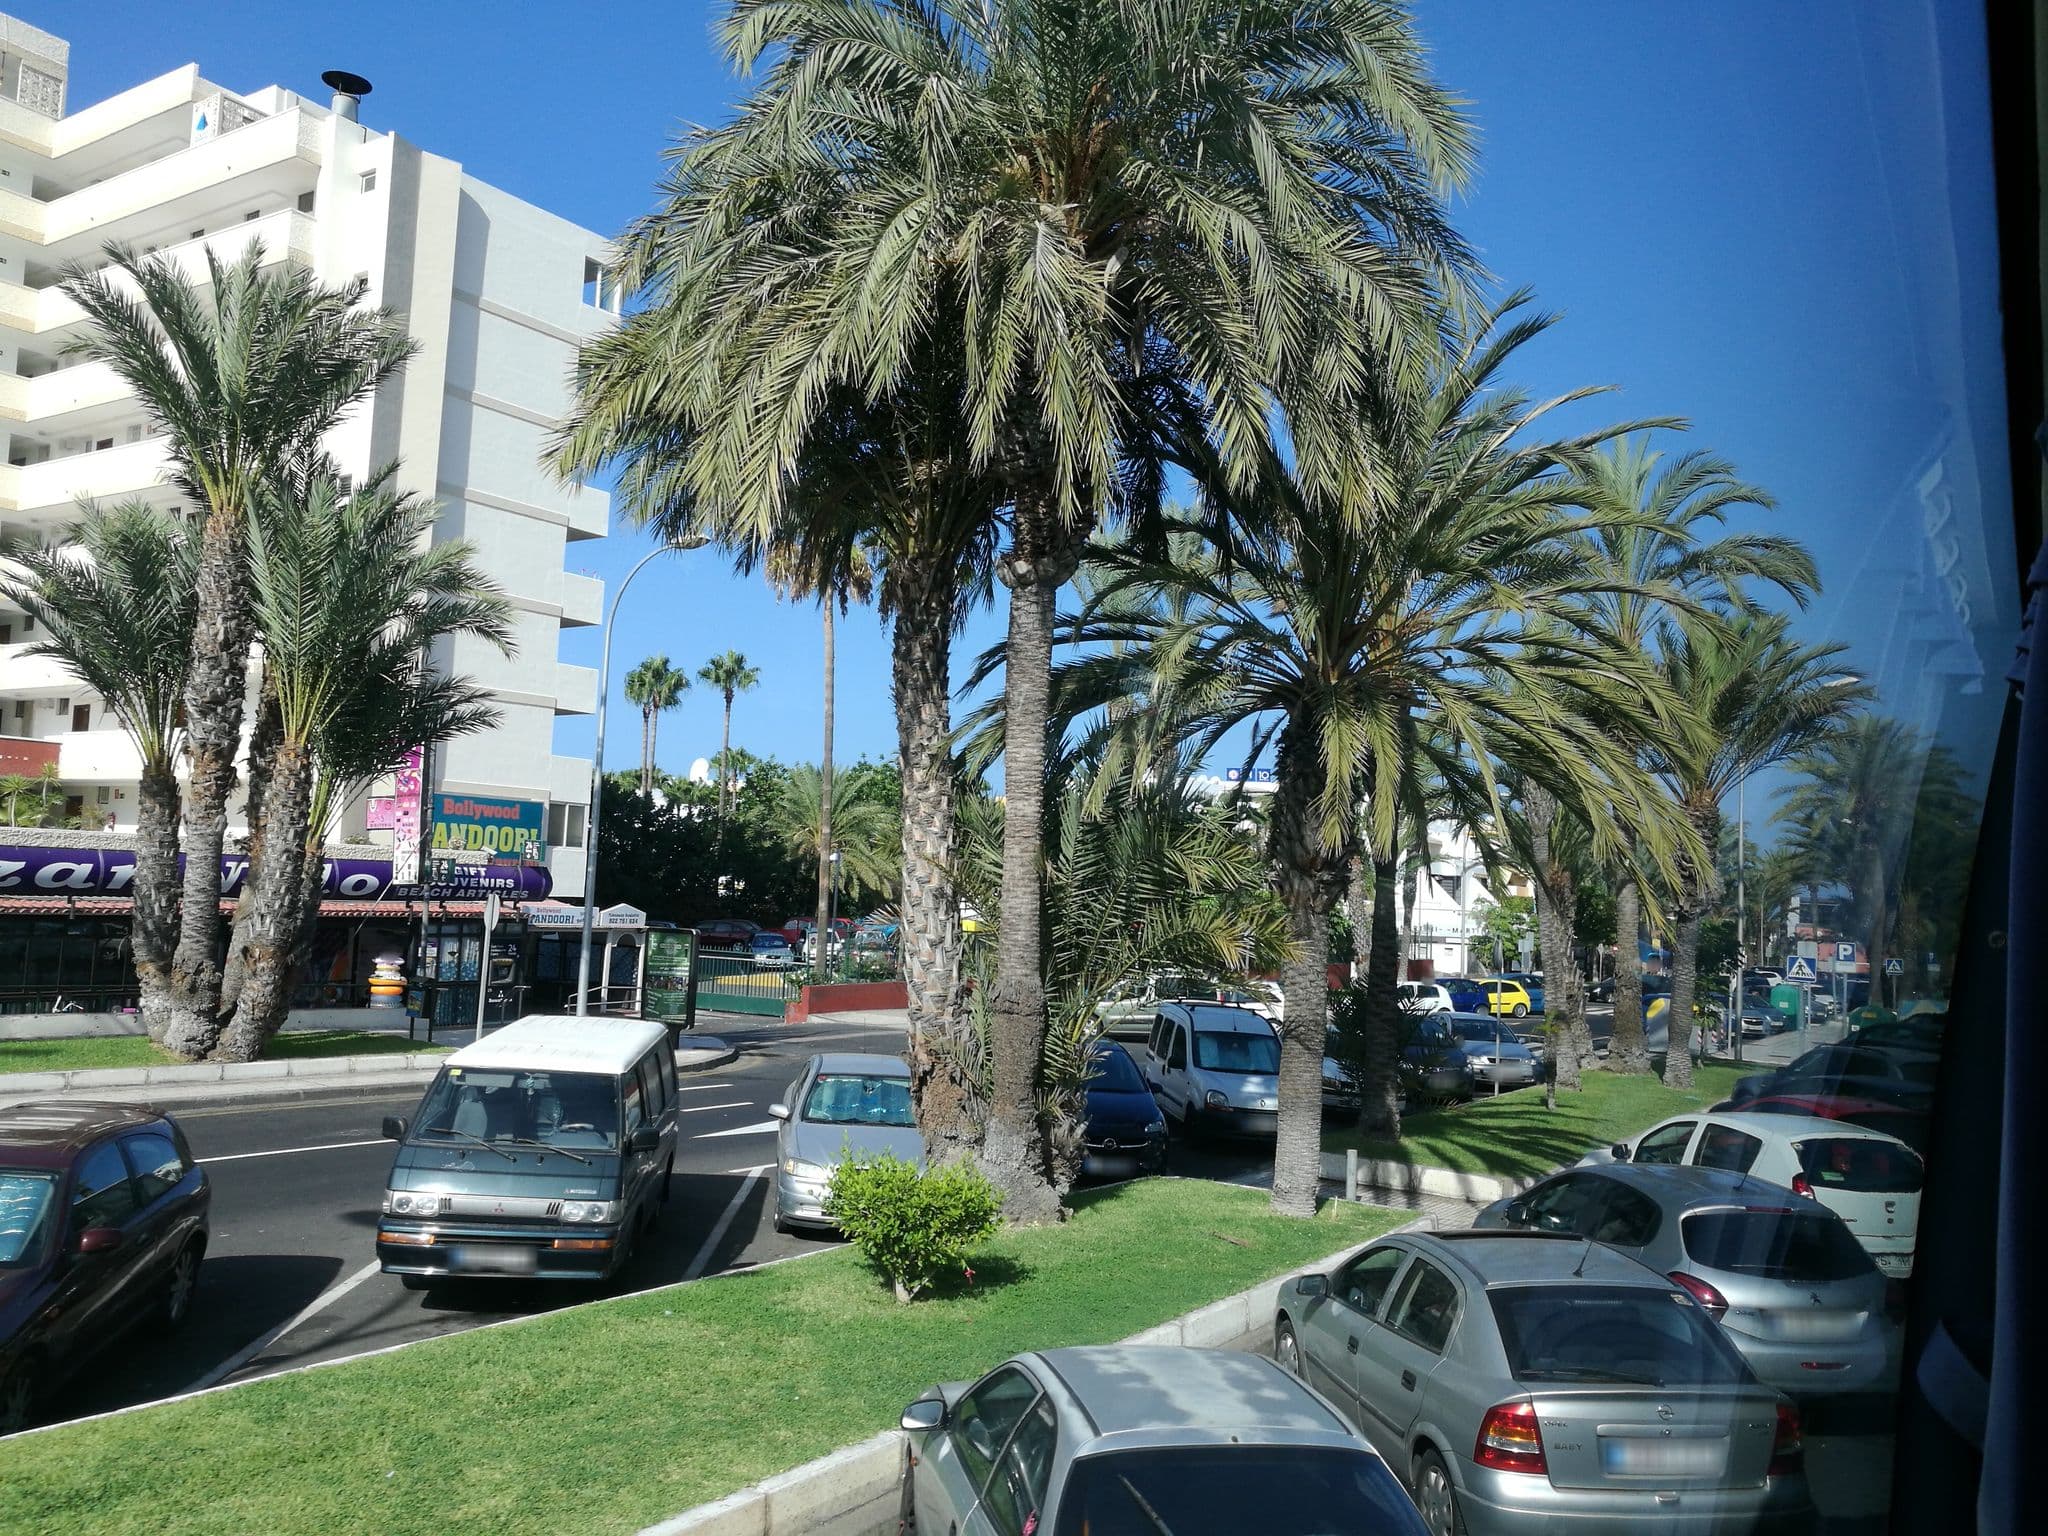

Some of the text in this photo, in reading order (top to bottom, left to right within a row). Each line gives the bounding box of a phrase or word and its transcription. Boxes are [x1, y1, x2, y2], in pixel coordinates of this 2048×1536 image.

[443, 798, 520, 820] Bollywood
[454, 866, 487, 877] GIFT
[455, 889, 529, 899] ARTICLES
[1838, 944, 1853, 960] P
